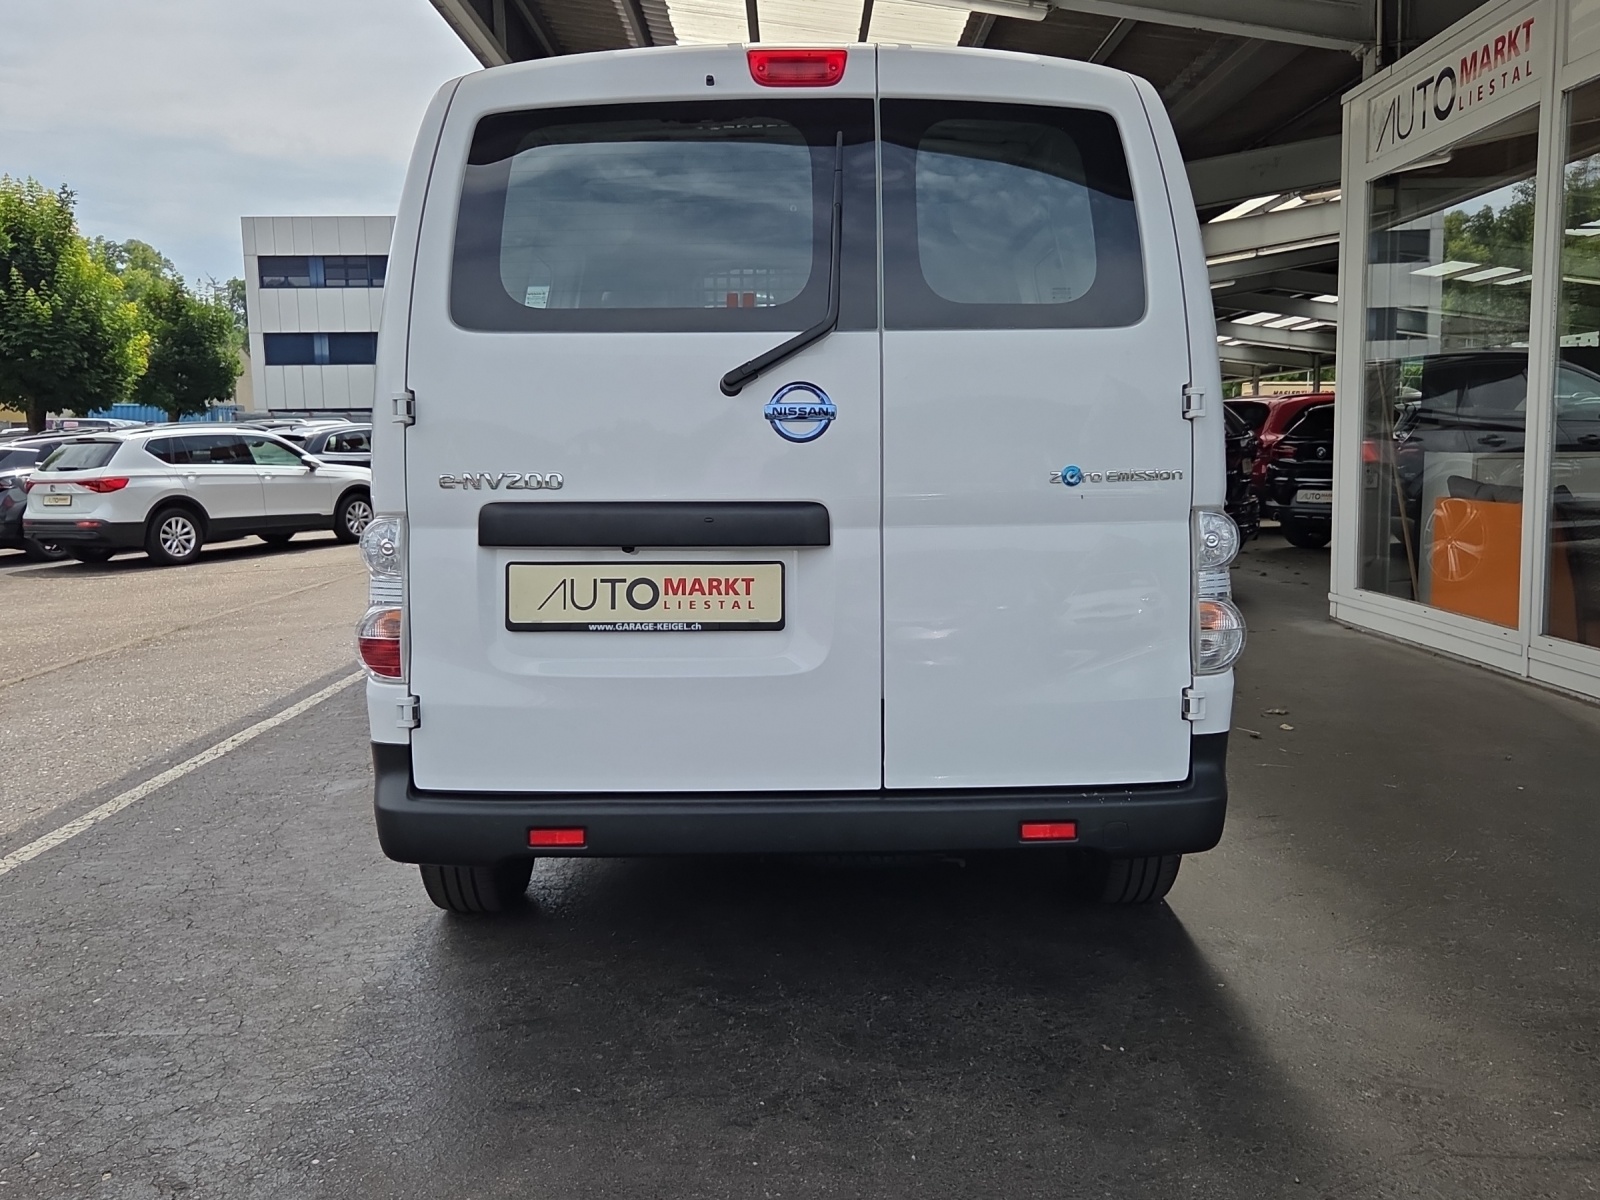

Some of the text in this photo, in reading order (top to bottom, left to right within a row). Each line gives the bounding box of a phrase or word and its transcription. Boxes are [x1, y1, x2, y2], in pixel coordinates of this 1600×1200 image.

[1375, 16, 1535, 153] AUTO MARKT
[1458, 59, 1533, 111] LIESTAL
[772, 406, 829, 416] NISSAN
[438, 472, 564, 490] e-NV200
[537, 577, 755, 611] AUTO MARKT
[663, 599, 755, 610] LIESTAL
[588, 622, 702, 632] www.GARAGE-KEIGEL.ch
